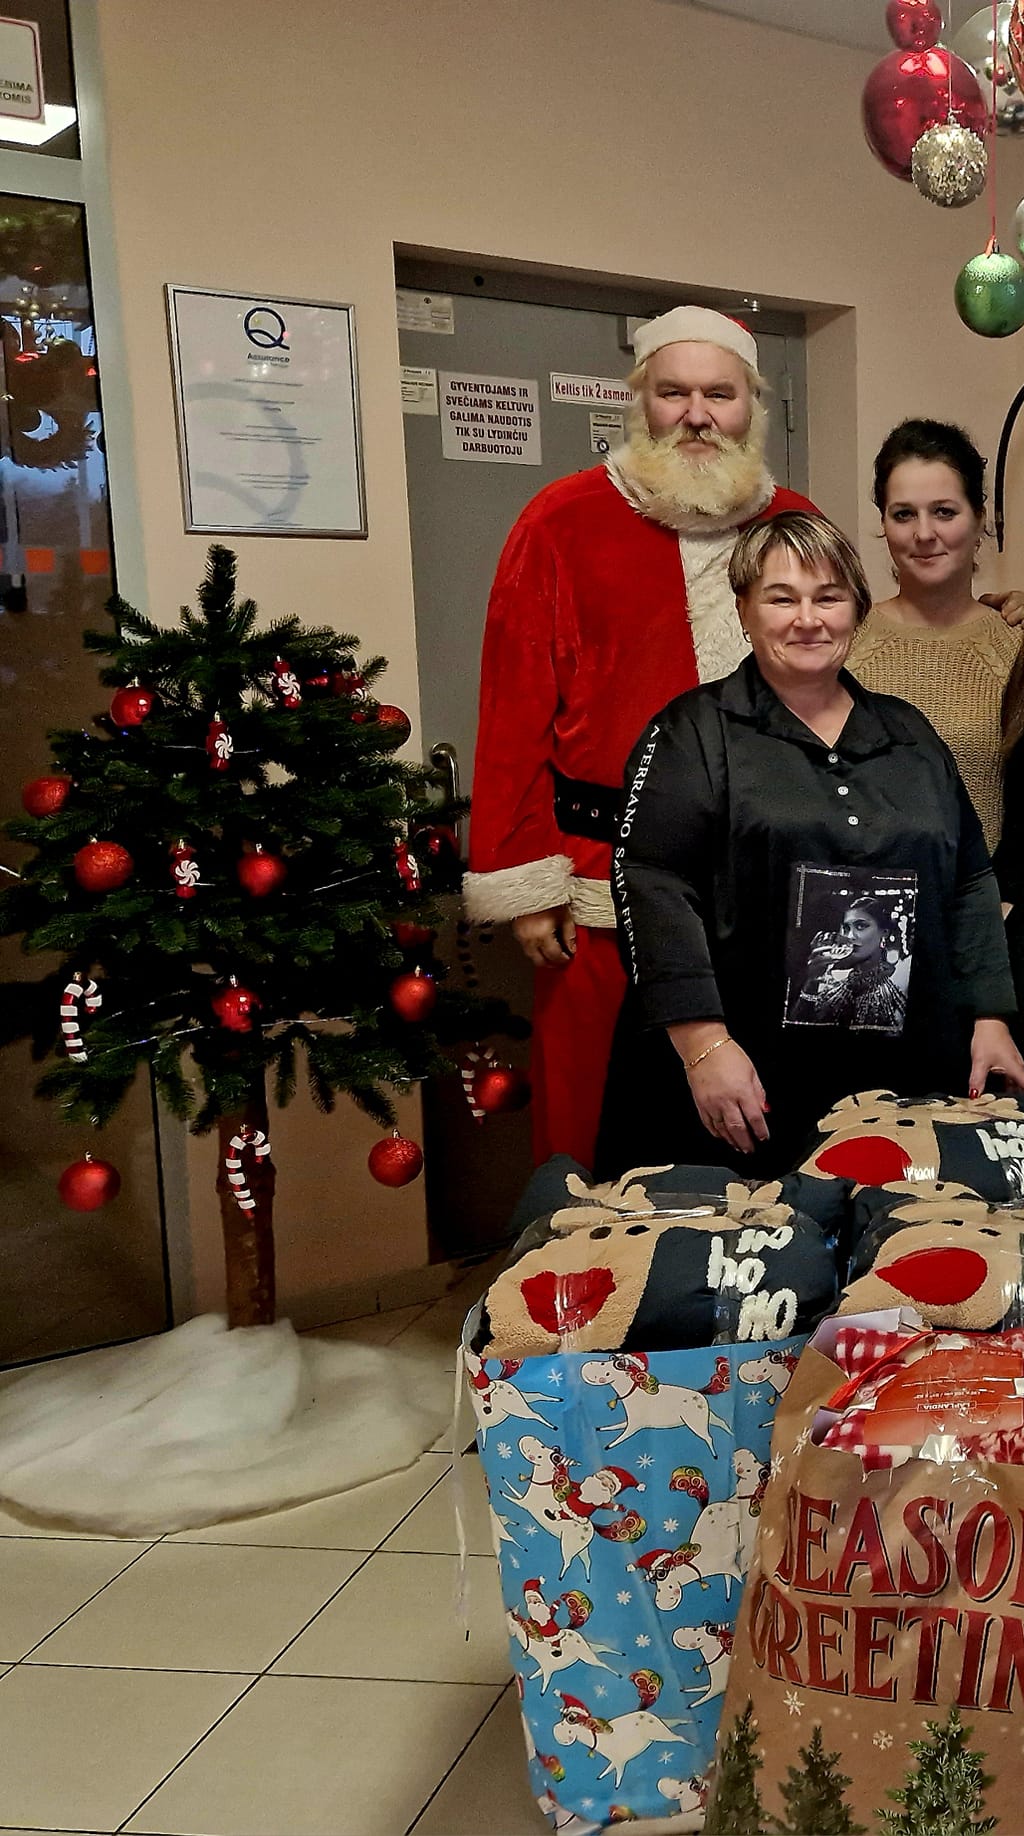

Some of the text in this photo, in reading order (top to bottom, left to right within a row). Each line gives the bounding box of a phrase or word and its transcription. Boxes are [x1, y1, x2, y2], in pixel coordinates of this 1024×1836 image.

[0, 91, 31, 104] OMIS
[450, 381, 528, 397] GYVENTOJAMS IR
[555, 382, 580, 396] Keltis
[582, 385, 593, 397] tik
[595, 383, 601, 398] 2
[446, 395, 534, 412] SVEČIAMS KELTUVU
[450, 410, 532, 427] GALIMA NAUDOTIS
[455, 426, 528, 441] TIK SU LYDINČIU
[463, 442, 522, 455] DARBUOTOJU
[620, 743, 656, 838] FERRANO
